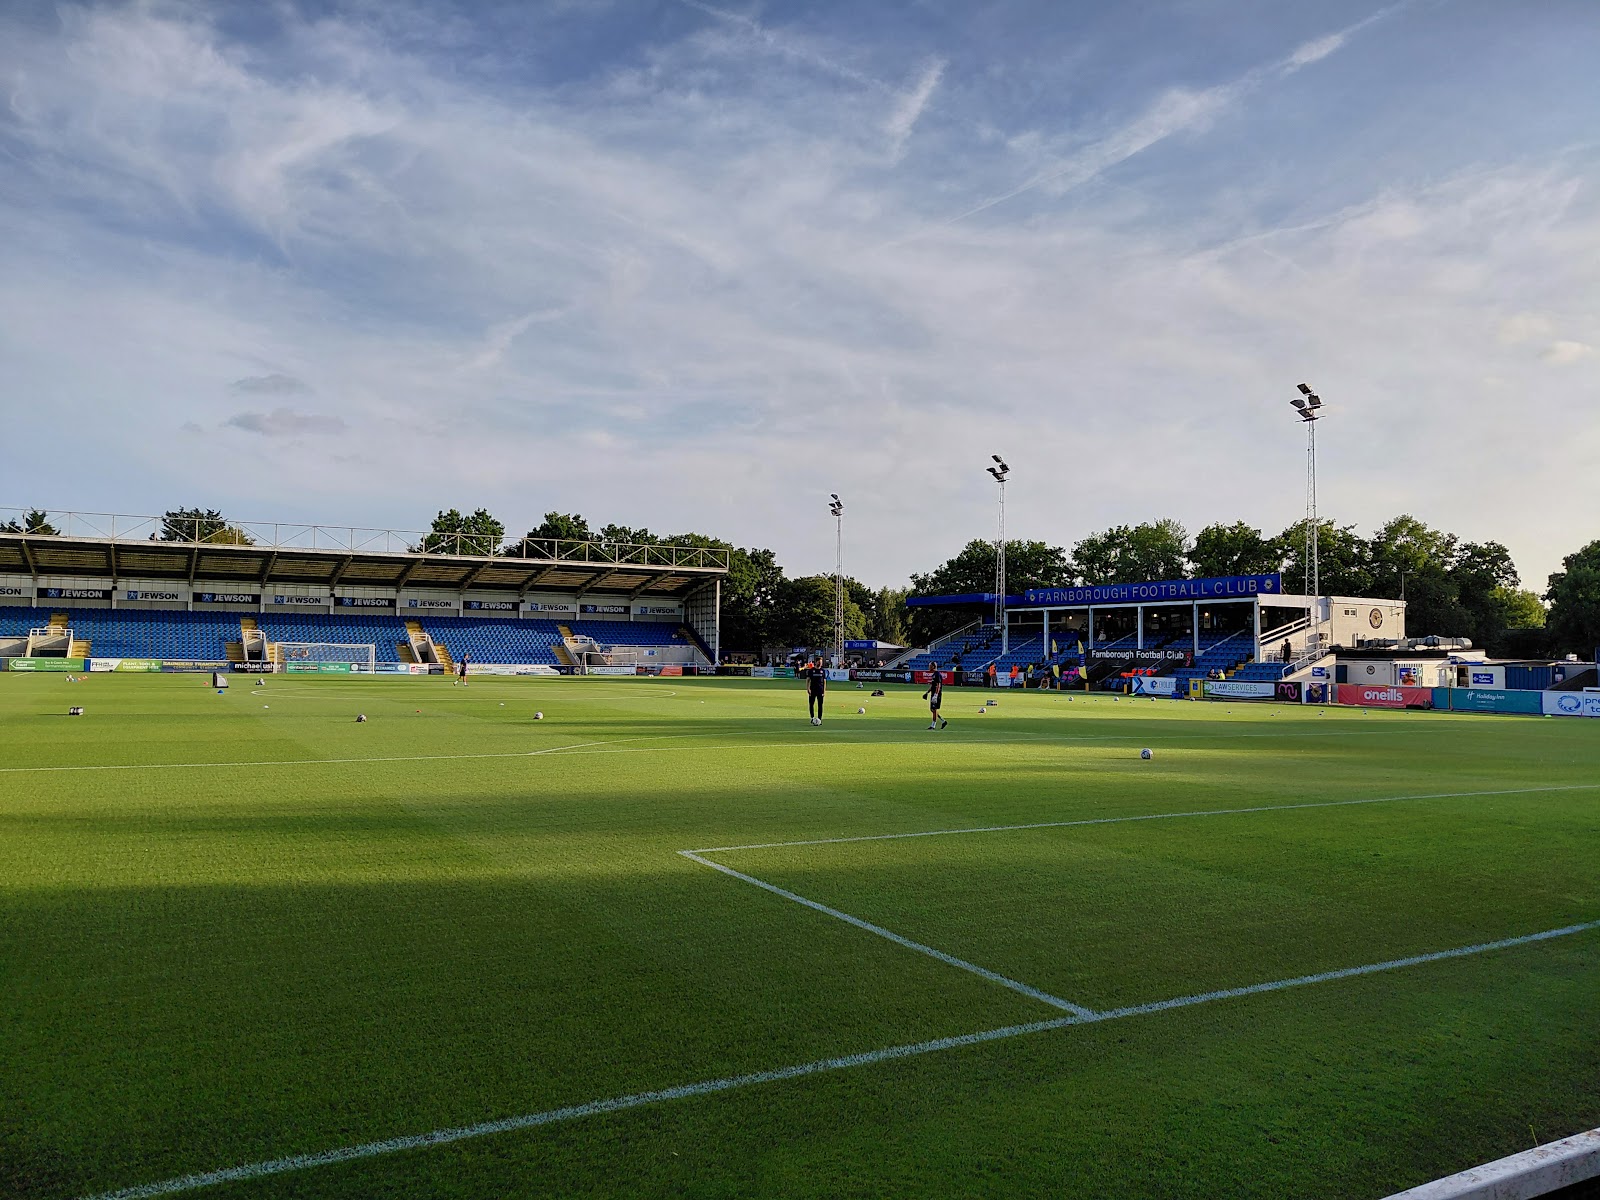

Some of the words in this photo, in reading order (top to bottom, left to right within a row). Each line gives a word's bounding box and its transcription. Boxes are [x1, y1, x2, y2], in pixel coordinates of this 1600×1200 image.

[61, 590, 103, 599] JEWSON
[1038, 588, 1128, 602] FARNBOROUGH
[1132, 582, 1208, 598] FOOTBALL
[1214, 580, 1257, 594] CLUB
[140, 592, 179, 600] JEWSON
[1091, 650, 1134, 660] Farnborough
[1136, 651, 1165, 659] Football
[1167, 651, 1184, 659] Club
[1214, 683, 1257, 691] LAWSERVICES
